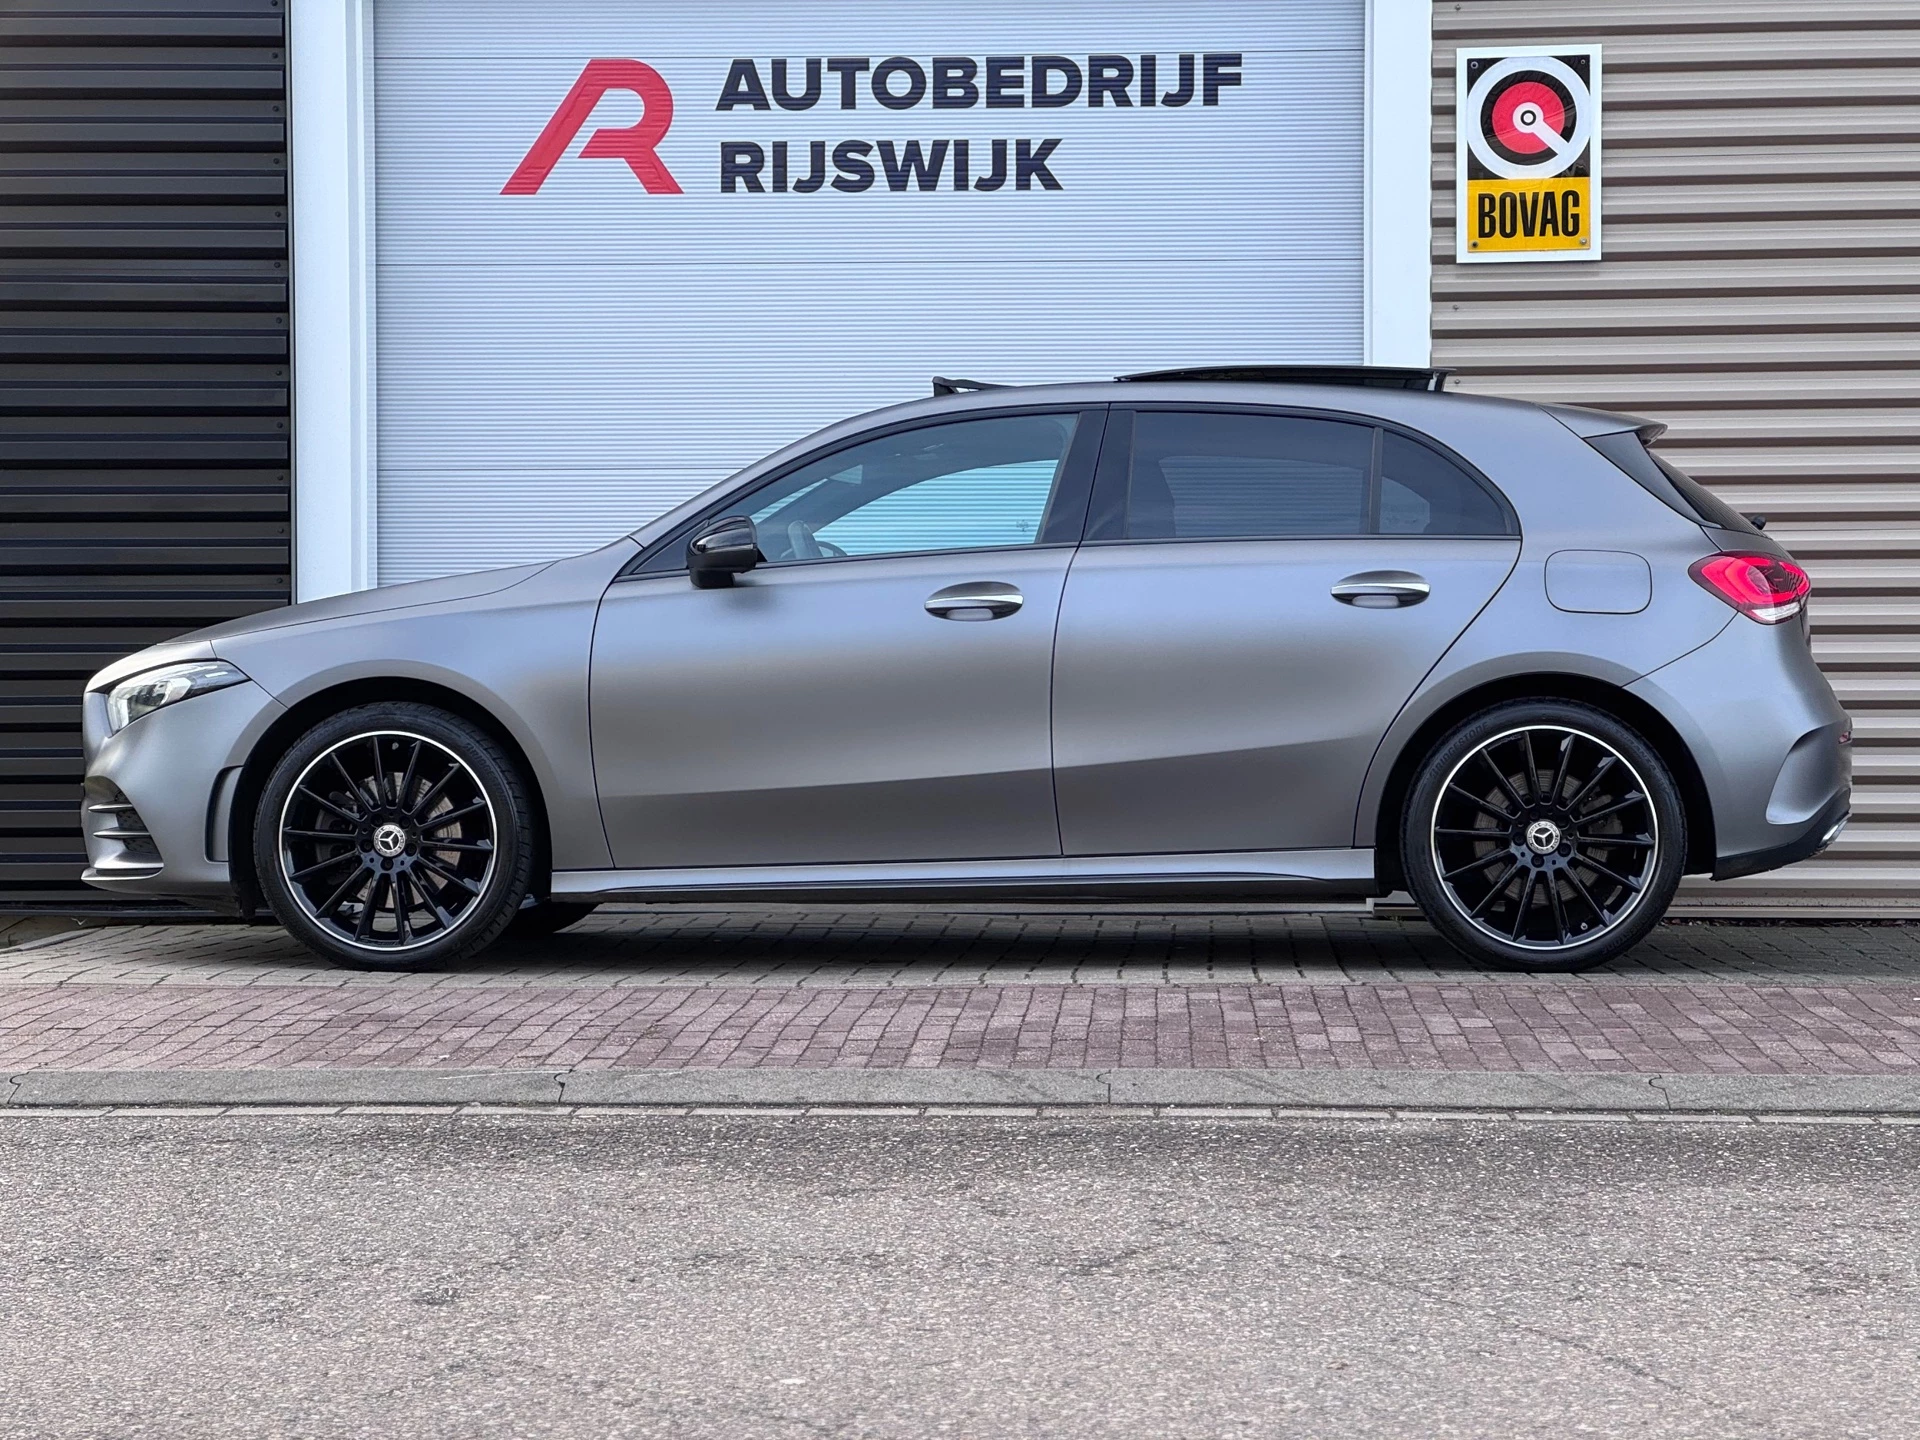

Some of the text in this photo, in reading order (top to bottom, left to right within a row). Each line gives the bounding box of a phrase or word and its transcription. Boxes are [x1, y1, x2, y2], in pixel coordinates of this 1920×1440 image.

[716, 54, 1241, 110] AUTOBEDRIJF
[721, 139, 1062, 193] RIJSWIJK
[1479, 190, 1579, 238] BOVAG
[1429, 720, 1489, 779] BRIDGESTONE
